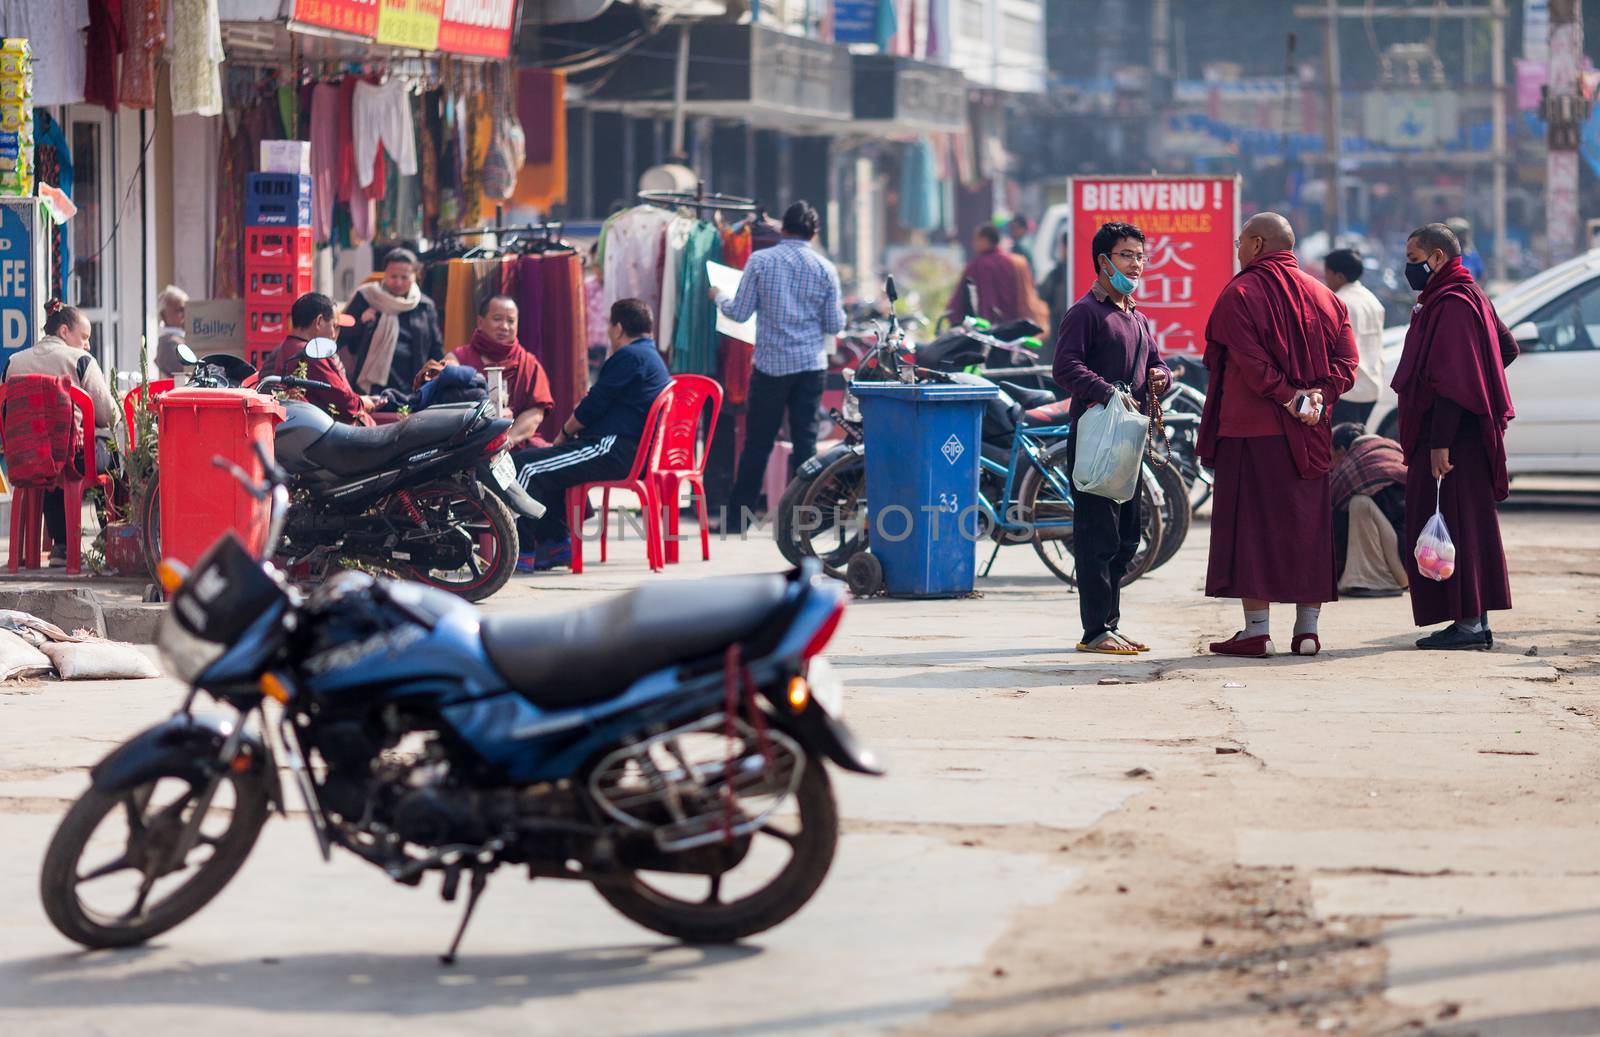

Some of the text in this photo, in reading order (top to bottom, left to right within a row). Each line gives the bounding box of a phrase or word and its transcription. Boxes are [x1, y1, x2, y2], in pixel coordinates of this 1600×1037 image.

[1082, 183, 1205, 210] BIENVENU
[1133, 214, 1212, 233] AVAILABLE
[192, 318, 237, 336] Bailley
[939, 493, 958, 513] 33
